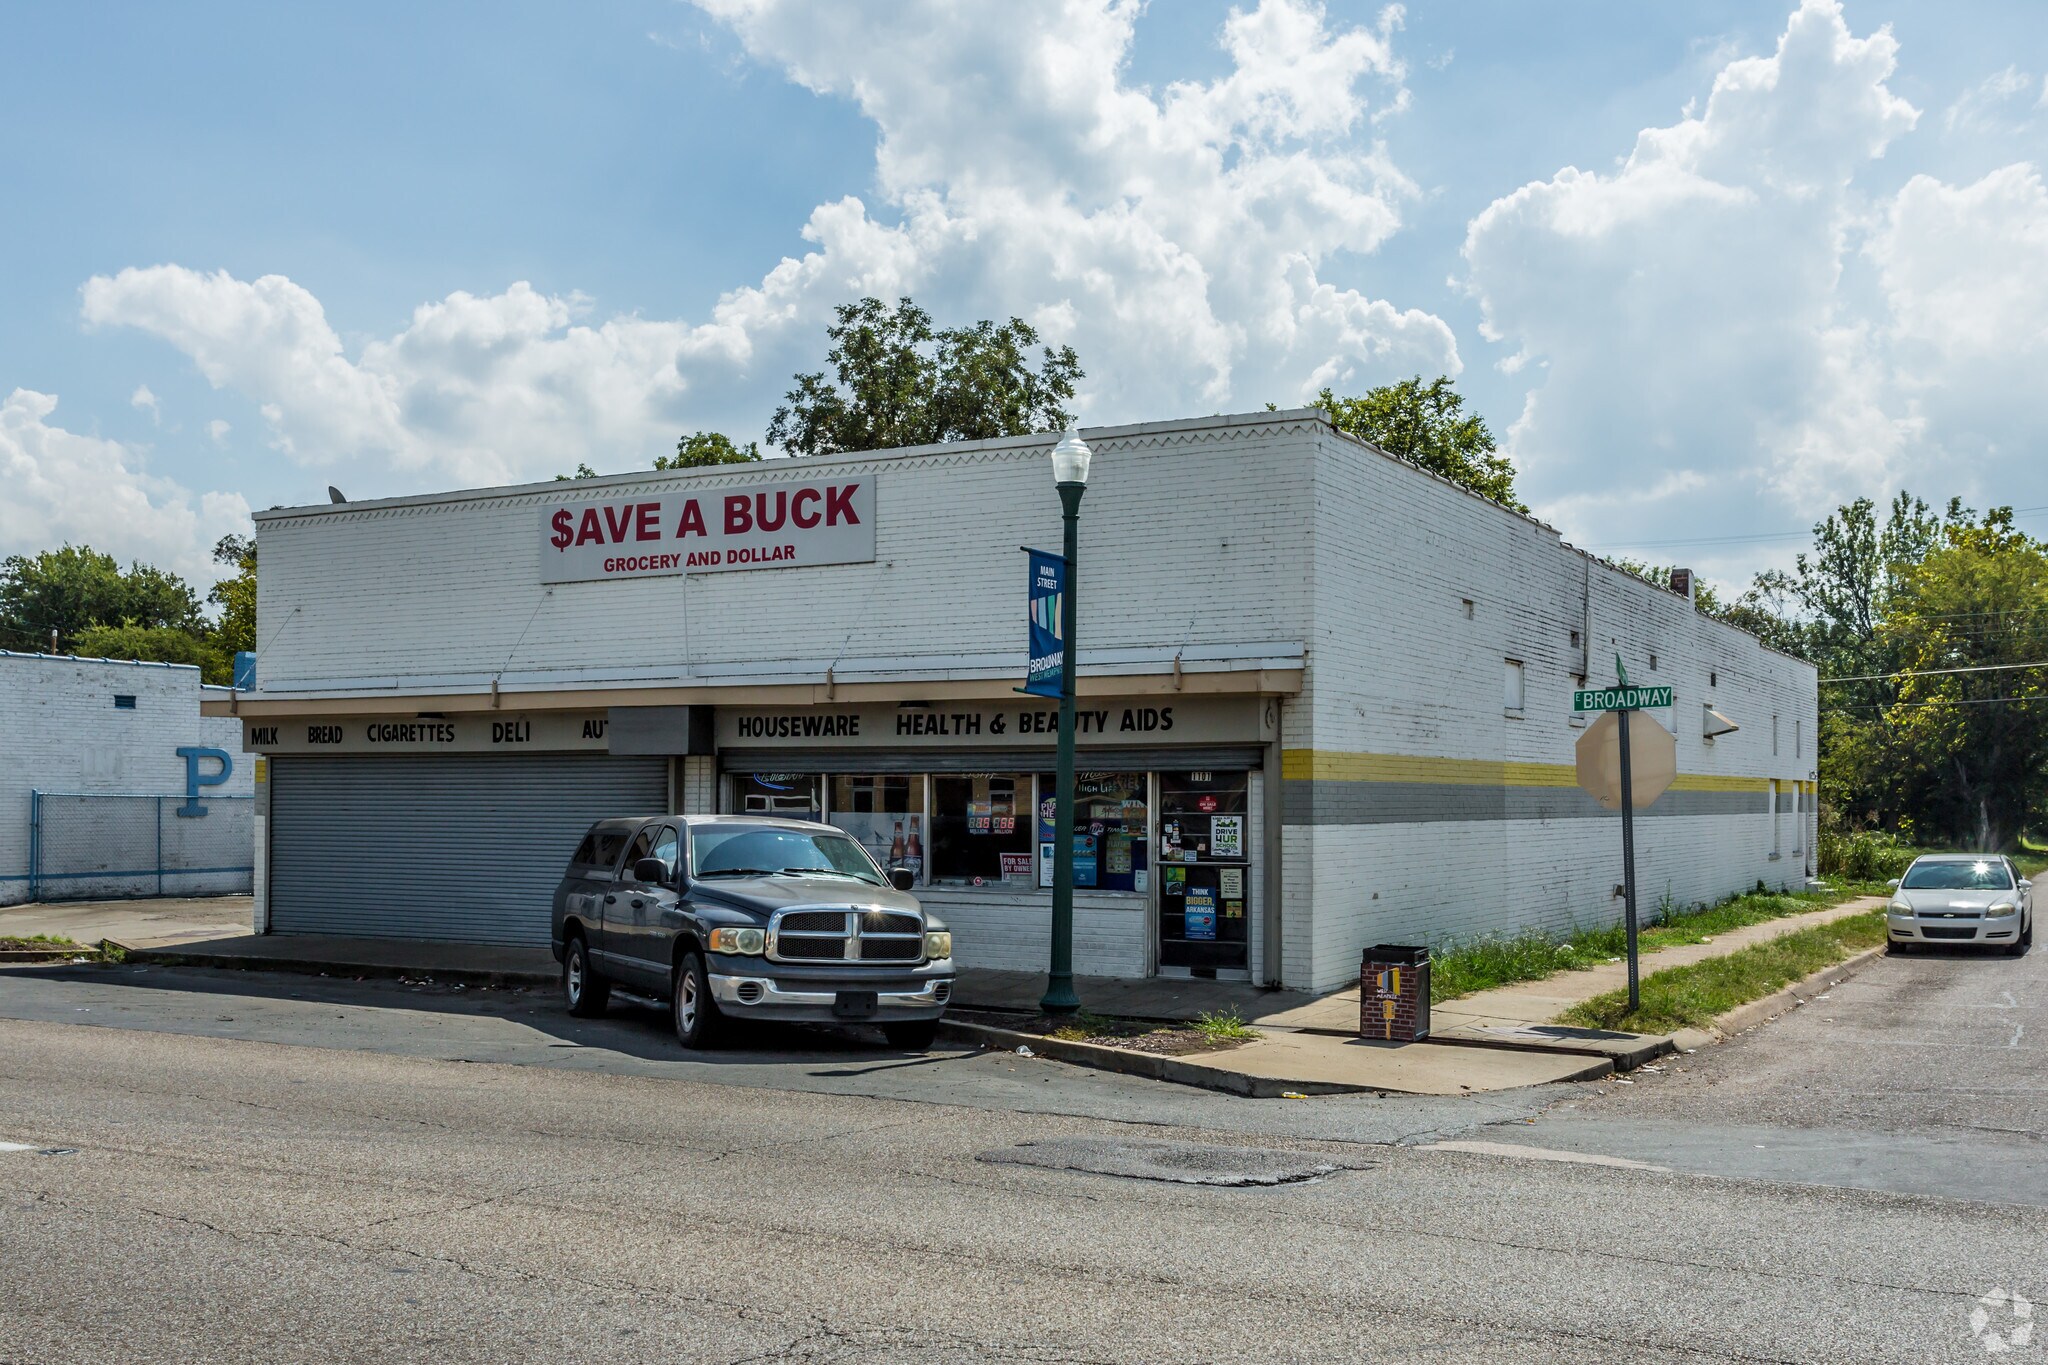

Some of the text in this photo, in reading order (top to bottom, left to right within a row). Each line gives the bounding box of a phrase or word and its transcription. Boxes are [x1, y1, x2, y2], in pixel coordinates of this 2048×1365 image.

[550, 483, 861, 552] $AVE A BUCK
[603, 545, 796, 573] GROCERY AND DOLLAR
[1040, 565, 1055, 577] MAIN
[1037, 577, 1057, 589] STREET
[1030, 651, 1063, 673] BROADWAY
[1575, 688, 1670, 709] E BROADWAY
[251, 719, 609, 746] MILK BREAD CIGARETTES DELI AU
[738, 715, 860, 738] HOUSEWARE
[896, 714, 981, 736] HEALTH
[989, 713, 1007, 735] &
[1119, 707, 1174, 732] AIDS
[176, 746, 233, 818] P
[1041, 802, 1056, 812] PLA
[1215, 835, 1238, 843] 4UR
[1003, 857, 1033, 865] FOR SALE
